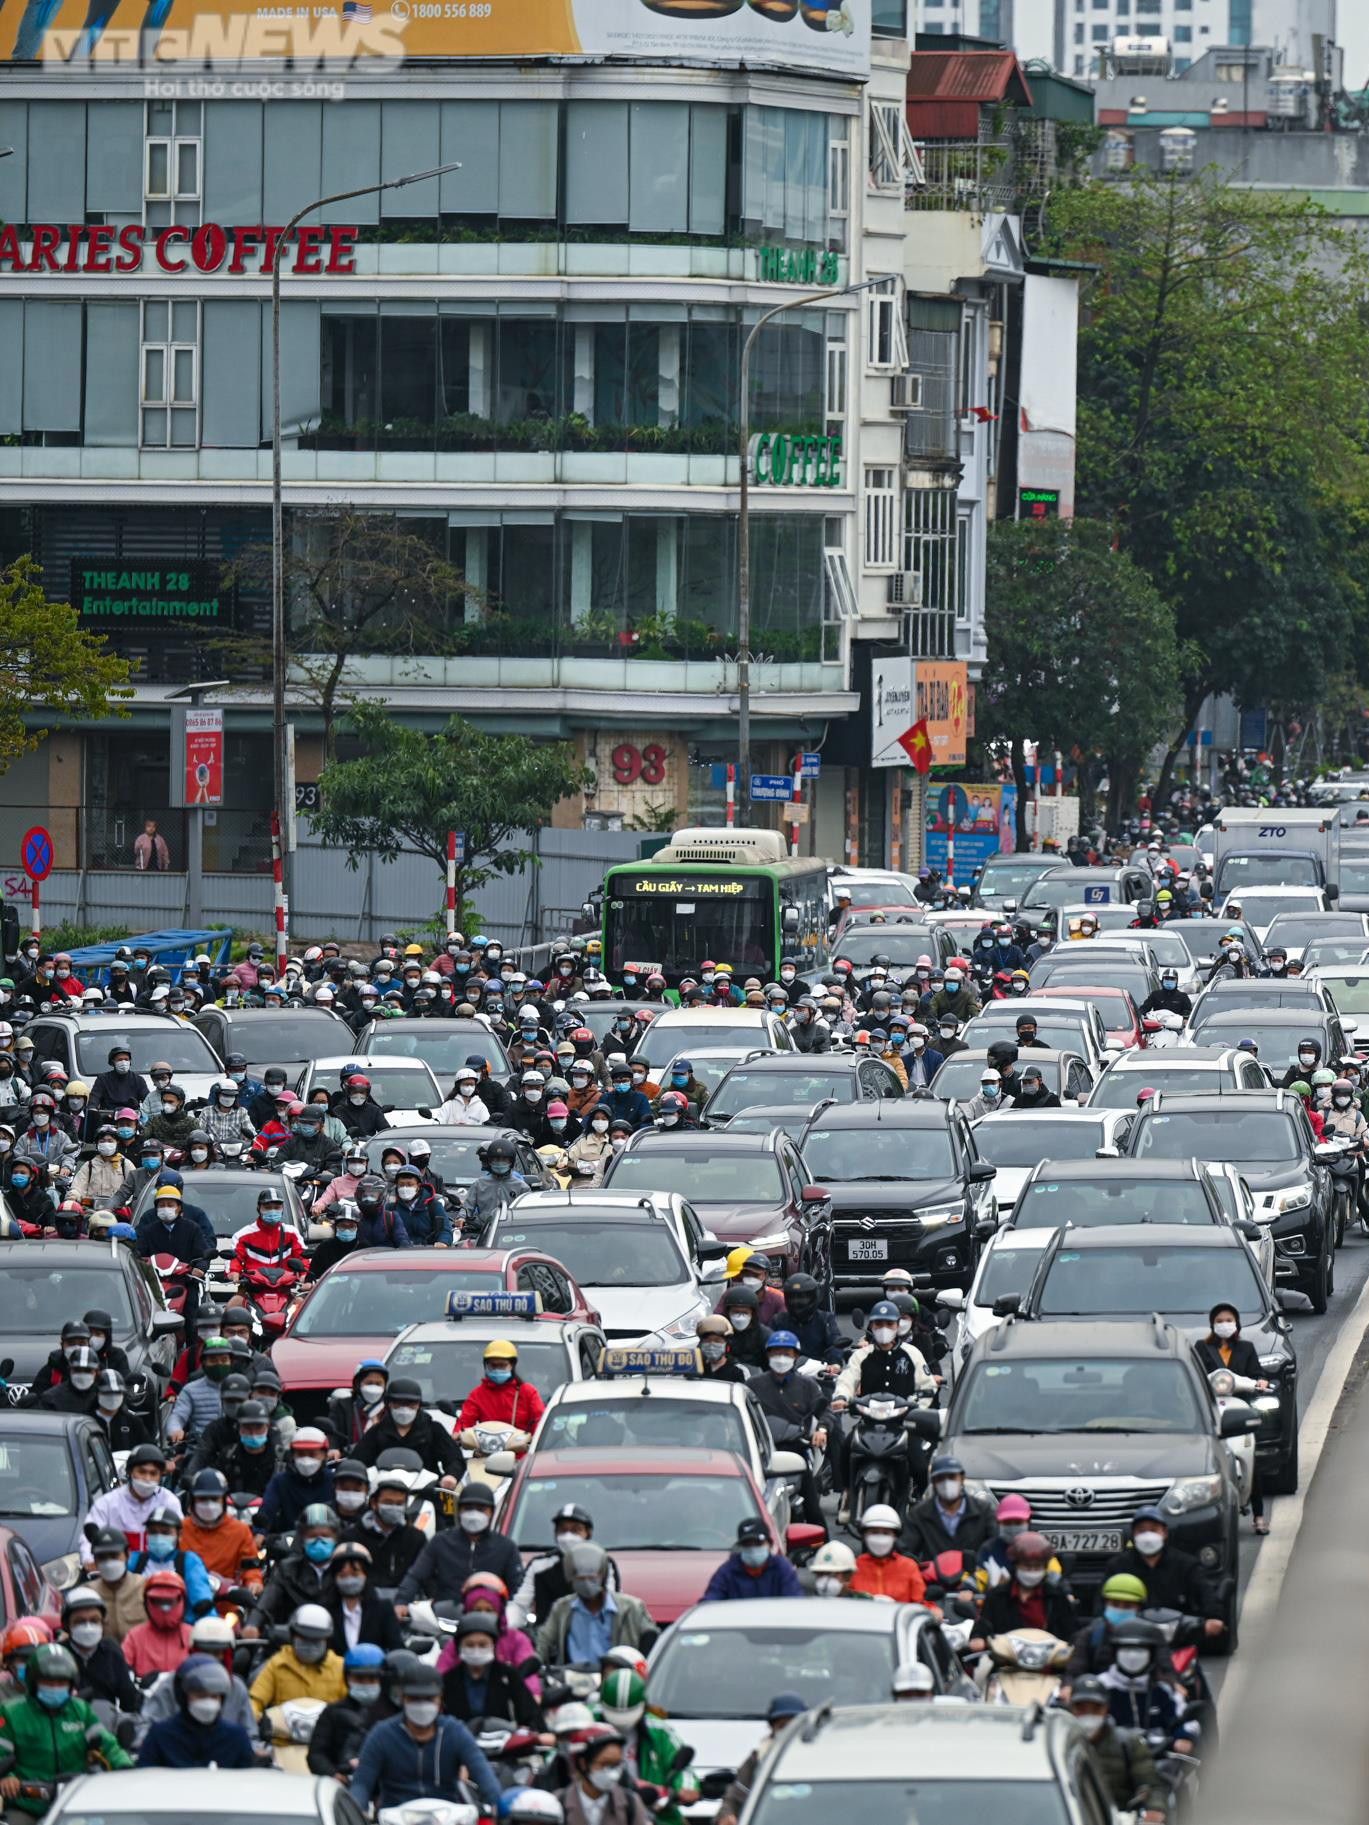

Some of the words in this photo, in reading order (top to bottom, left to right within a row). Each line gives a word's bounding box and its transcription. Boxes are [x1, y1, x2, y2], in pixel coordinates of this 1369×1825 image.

[256, 7, 292, 19] MADE
[296, 7, 309, 18] IN
[313, 7, 338, 18] USA
[412, 4, 441, 18] 1800
[445, 4, 466, 18] 556
[469, 4, 491, 17] 889
[155, 223, 359, 273] COFFEE
[820, 250, 838, 284] 28
[755, 432, 842, 486] COFFEE
[82, 571, 161, 590] THEANH
[165, 572, 190, 590] 28
[82, 596, 220, 617] Entertainment
[612, 744, 666, 785] 93
[296, 786, 316, 805] 93
[1258, 826, 1287, 838] ZTO
[636, 880, 656, 892] CẦU
[698, 884, 718, 893] TAM
[721, 882, 743, 895] HIỆP
[860, 1241, 877, 1250] 30H
[853, 1250, 884, 1259] 570.05
[473, 1299, 492, 1311] SAO
[629, 1353, 651, 1366] SAO
